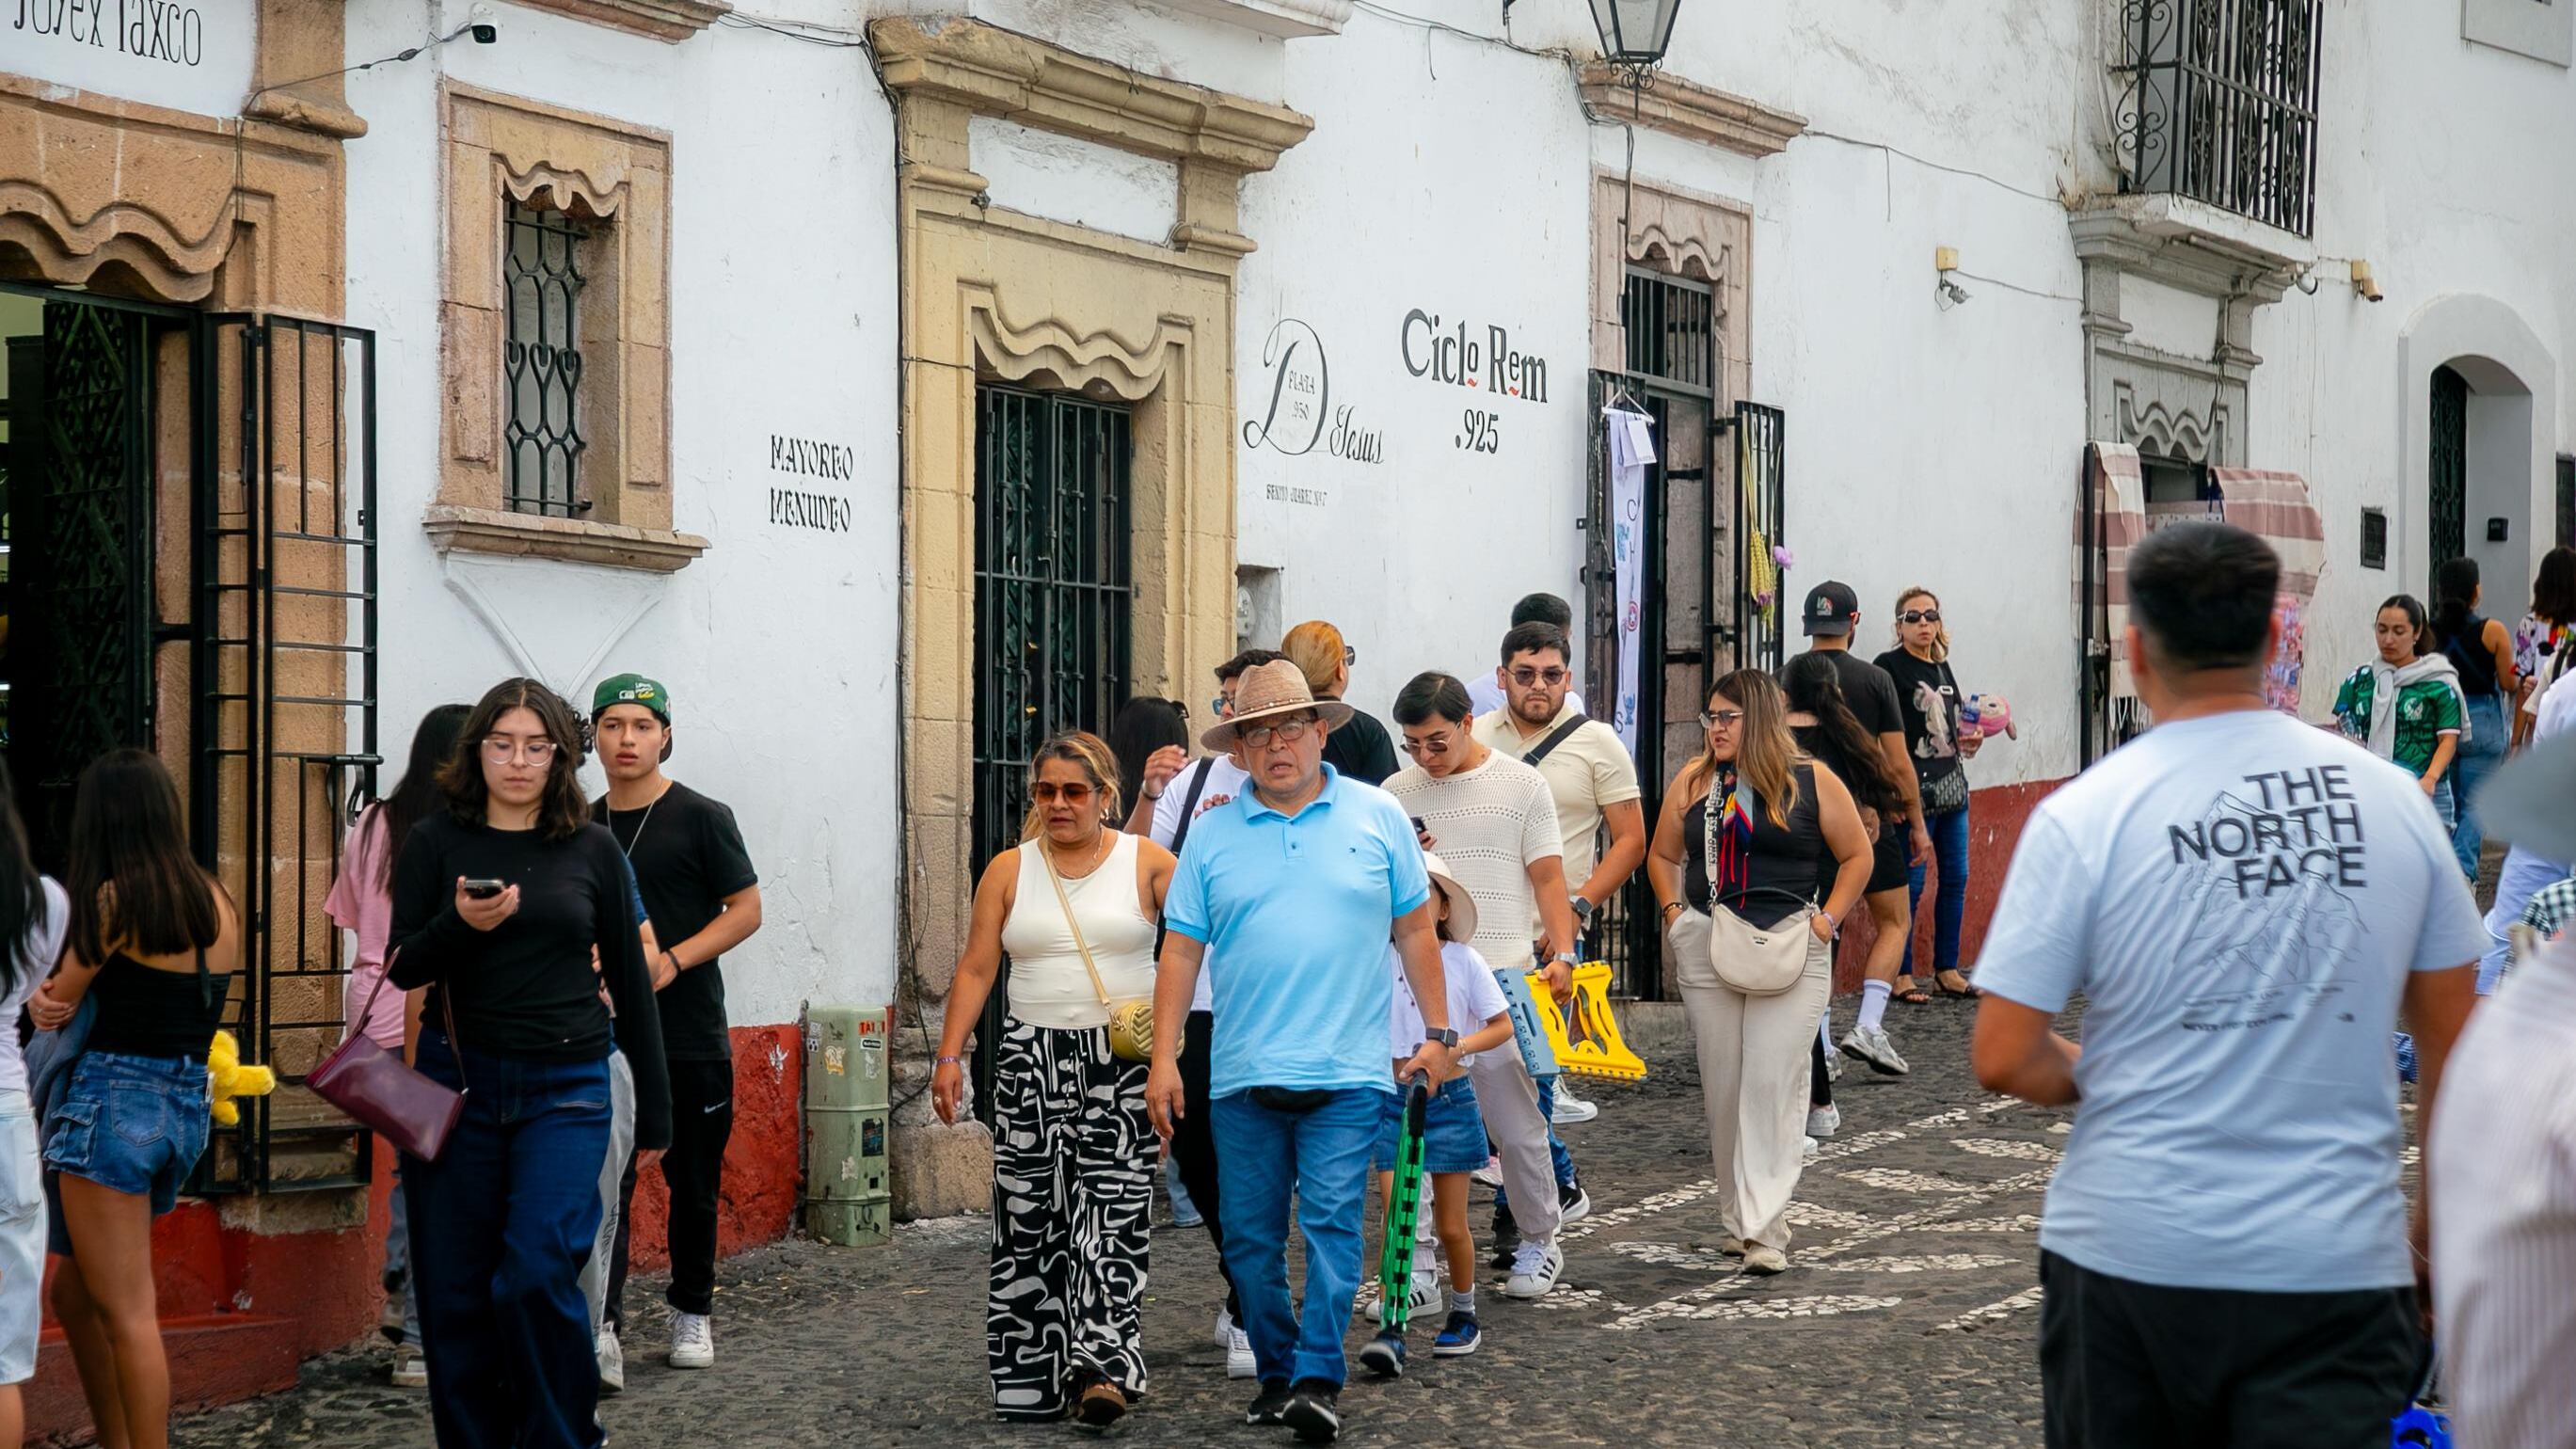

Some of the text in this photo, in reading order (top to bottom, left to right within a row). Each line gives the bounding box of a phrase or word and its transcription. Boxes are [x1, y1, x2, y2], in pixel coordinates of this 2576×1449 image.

[119, 0, 201, 66] Taxco
[1402, 308, 1548, 404] Ciclo Rem
[1243, 306, 1384, 464] D Jesus
[771, 434, 853, 481] MAYOREO
[1455, 408, 1499, 454] .925
[771, 486, 851, 533] MENUDEO
[2243, 765, 2356, 810] THE
[2168, 803, 2365, 864] NORTH
[2234, 846, 2368, 899] FACE
